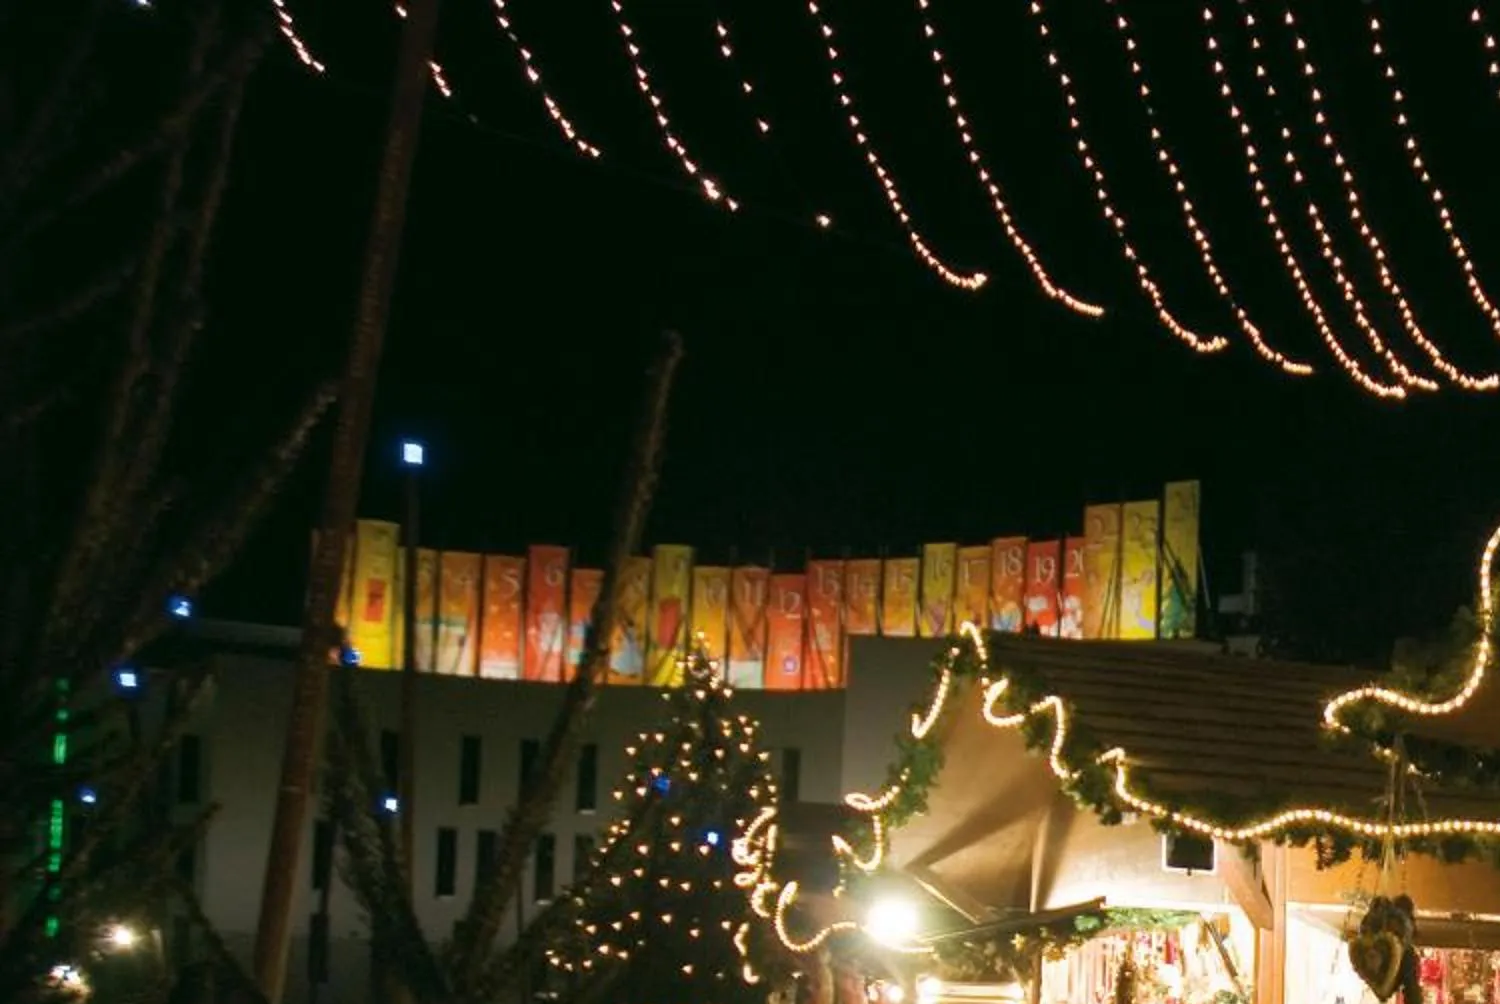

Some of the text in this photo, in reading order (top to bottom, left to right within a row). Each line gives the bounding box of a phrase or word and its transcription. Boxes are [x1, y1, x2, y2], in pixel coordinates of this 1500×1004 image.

[545, 556, 564, 586] 6
[1000, 546, 1021, 577] 18
[1033, 556, 1054, 584] 19
[499, 568, 520, 599] 5
[778, 588, 800, 620] 12
